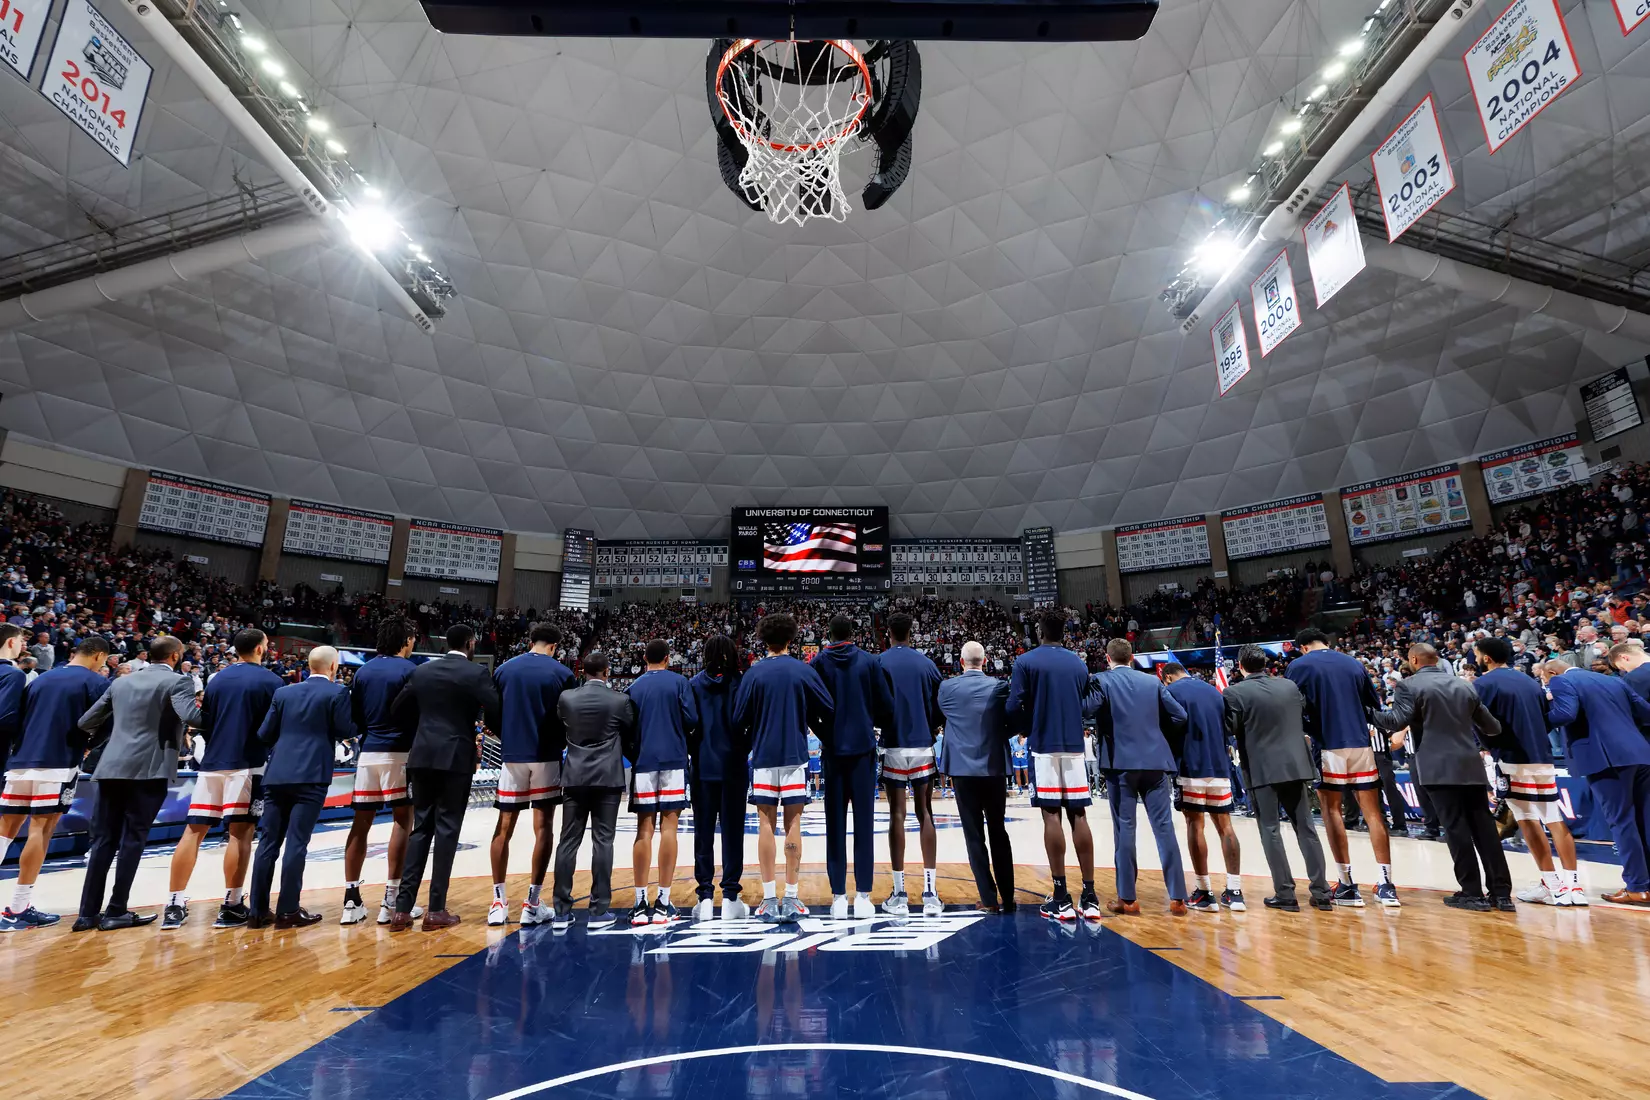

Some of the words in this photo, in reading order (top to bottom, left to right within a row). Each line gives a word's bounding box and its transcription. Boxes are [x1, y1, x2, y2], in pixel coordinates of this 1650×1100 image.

[86, 6, 114, 37] UConn
[116, 36, 138, 62] Men's
[89, 20, 132, 65] Basketball
[1472, 27, 1497, 54] UConn
[1486, 5, 1527, 52] Basketball
[1491, 33, 1511, 57] NCAA
[62, 60, 125, 129] 2014
[1487, 40, 1560, 121] 2004
[1500, 71, 1558, 125] NATIONAL
[53, 92, 119, 154] CHAMPIONS
[62, 84, 118, 140] NATIONAL
[1498, 75, 1566, 140] CHAMPIONS
[1378, 136, 1396, 156] UConn
[1397, 104, 1426, 135] Women's
[1388, 121, 1418, 156] Basketball
[1389, 154, 1440, 213] 2003
[1396, 181, 1439, 220] NATIONAL
[1396, 186, 1445, 233] CHAMPIONS
[1261, 297, 1292, 335] 2000
[1267, 316, 1292, 339] NATIONAL
[1266, 322, 1296, 351] CHAMPIONS
[1220, 345, 1242, 374] 1995
[1482, 452, 1508, 462] NCAA
[1514, 434, 1577, 454] CHAMPIONS
[1512, 452, 1537, 460] FINAL
[1347, 483, 1371, 492] NCAA
[1376, 466, 1451, 486] CHAMPIONSHIP
[1143, 516, 1200, 528] CHAMPIONSHIP
[1227, 508, 1248, 516] NCAA
[1252, 495, 1316, 511] CHAMPIONSHIP
[441, 524, 498, 534] CHAMPIONSHIP
[737, 581, 742, 589] 0
[885, 580, 890, 588] 0
